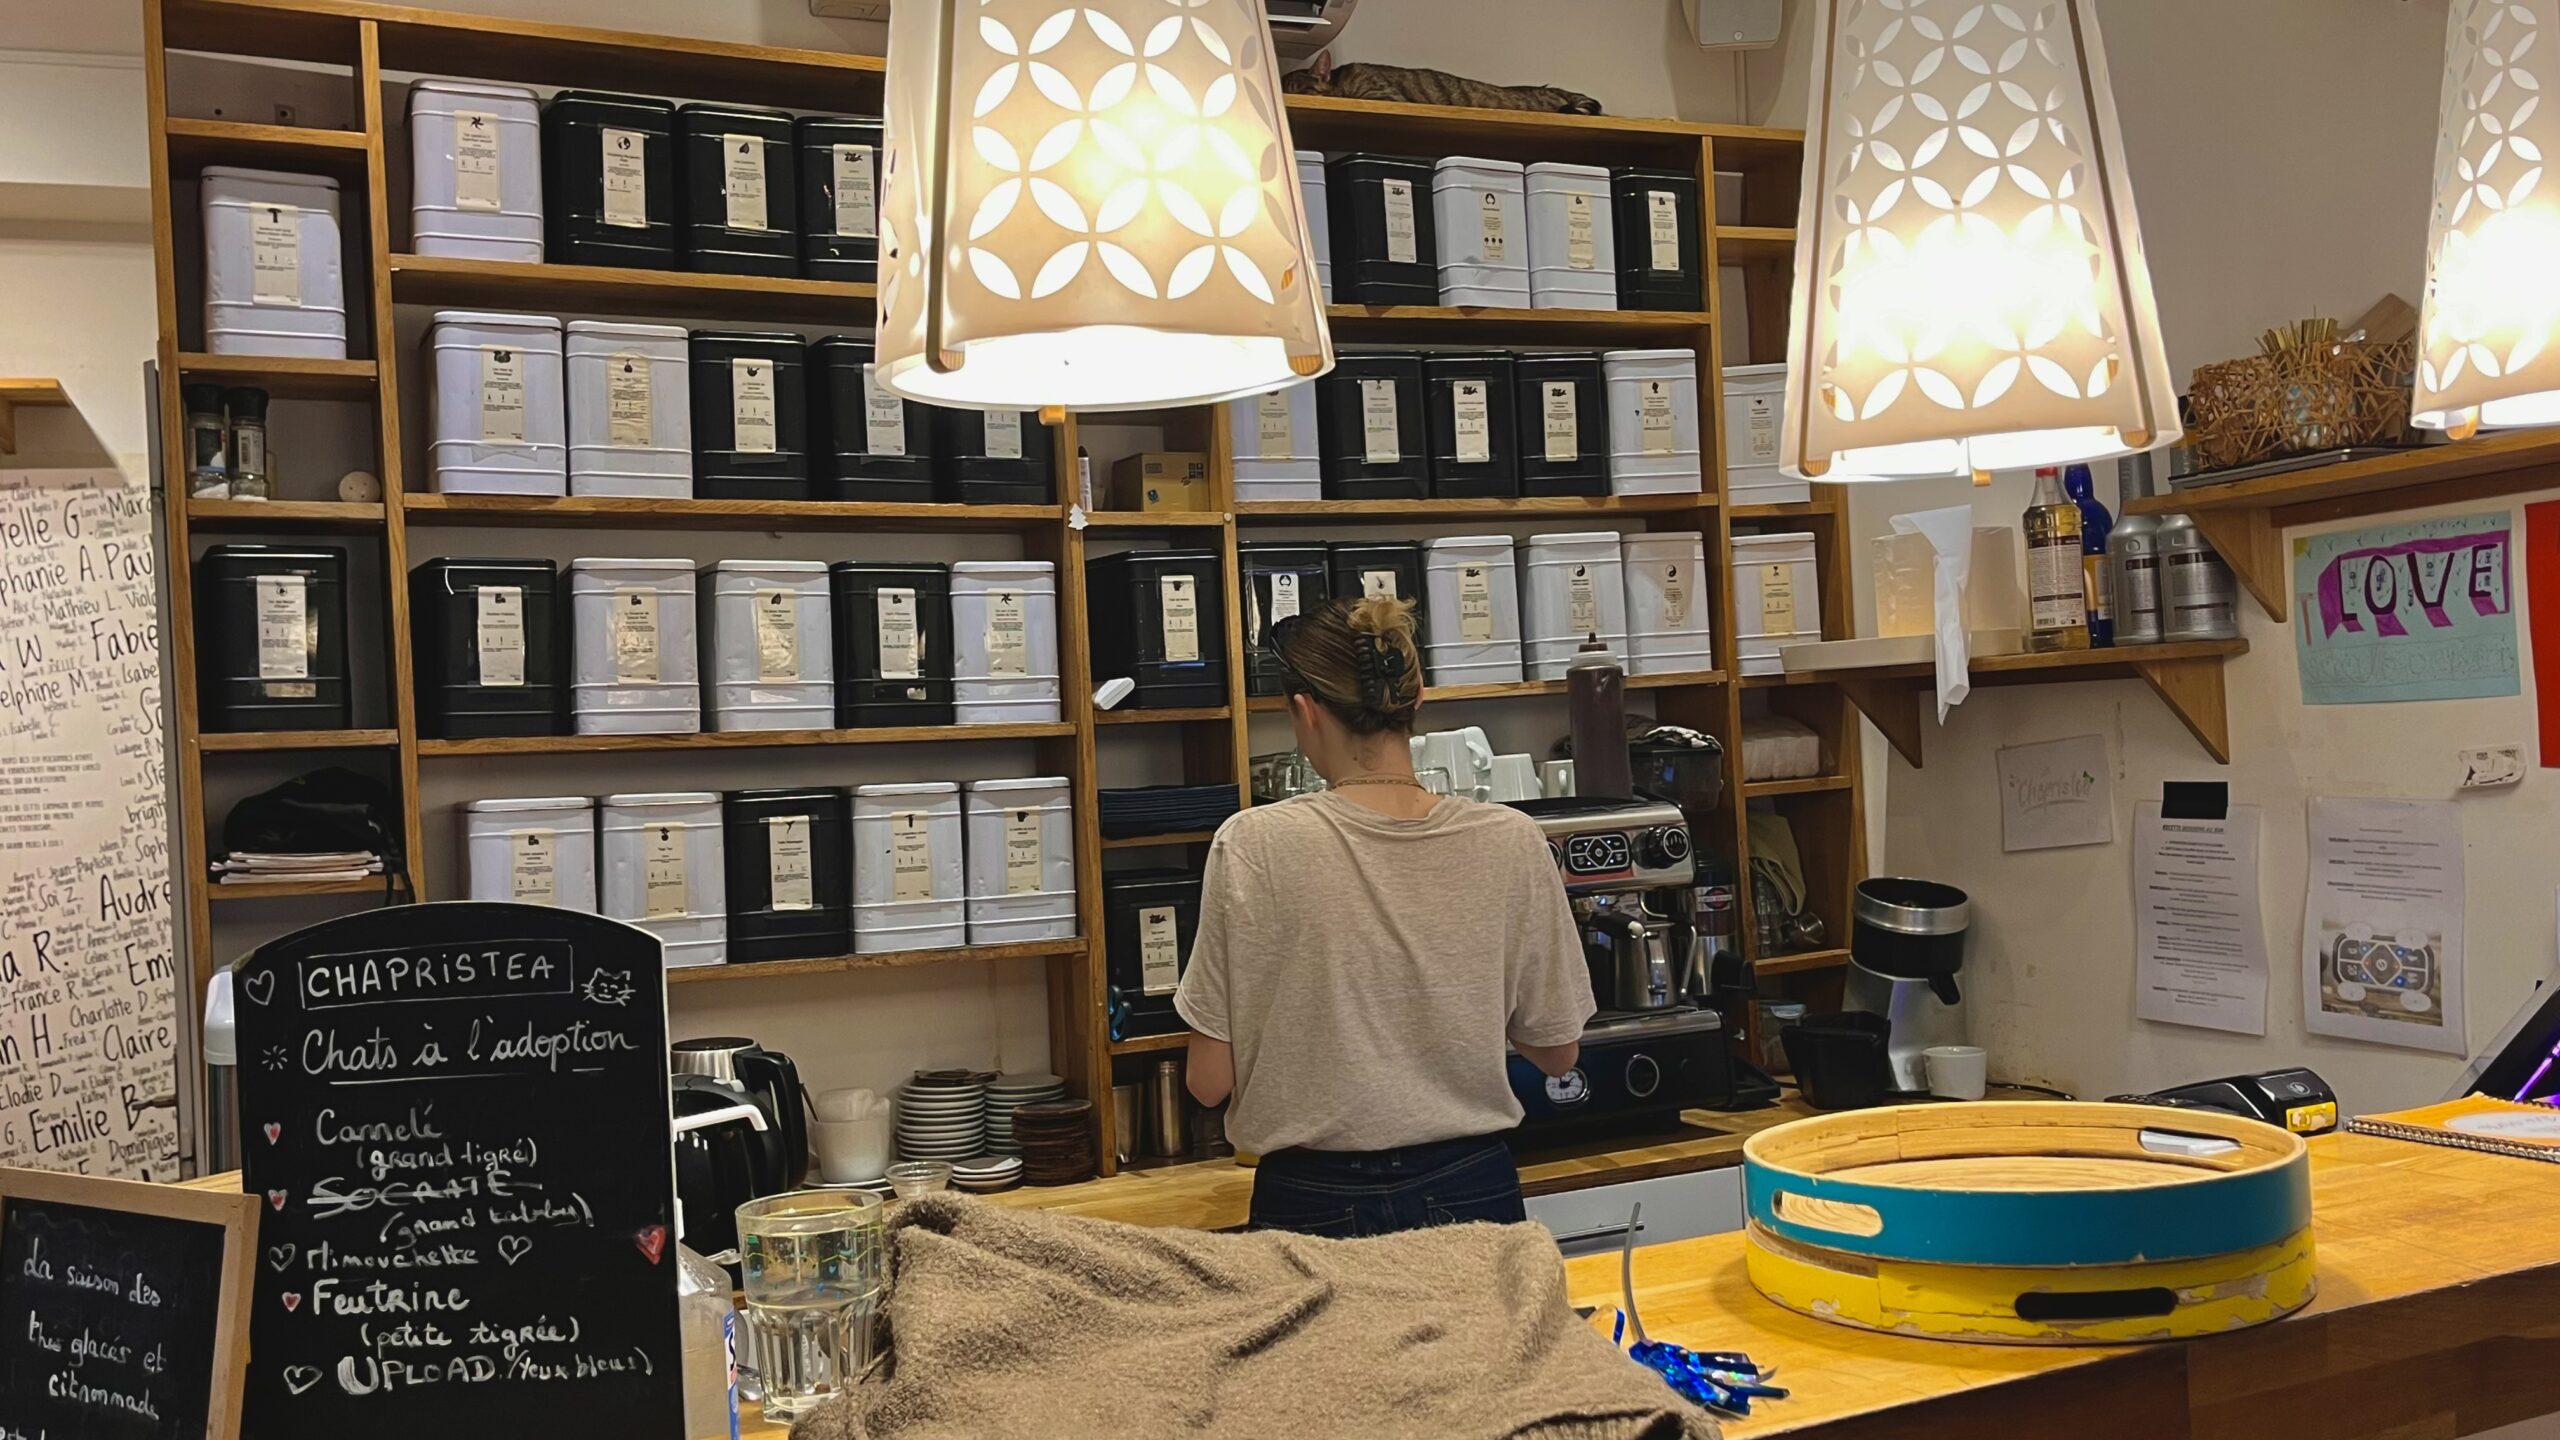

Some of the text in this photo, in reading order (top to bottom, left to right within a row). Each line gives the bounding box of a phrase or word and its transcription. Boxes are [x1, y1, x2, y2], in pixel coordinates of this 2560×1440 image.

[2324, 540, 2504, 630] LOVE
[43, 598, 100, 622] Mathieu
[0, 988, 62, 1013] -France
[70, 998, 134, 1028] Charlotte
[103, 1023, 173, 1062] Claire
[302, 1014, 642, 1075] Chats à l'adoption
[28, 1100, 111, 1153] Emilie
[108, 1131, 177, 1162] Dominique
[66, 1263, 121, 1296] saison
[143, 1341, 168, 1374] et
